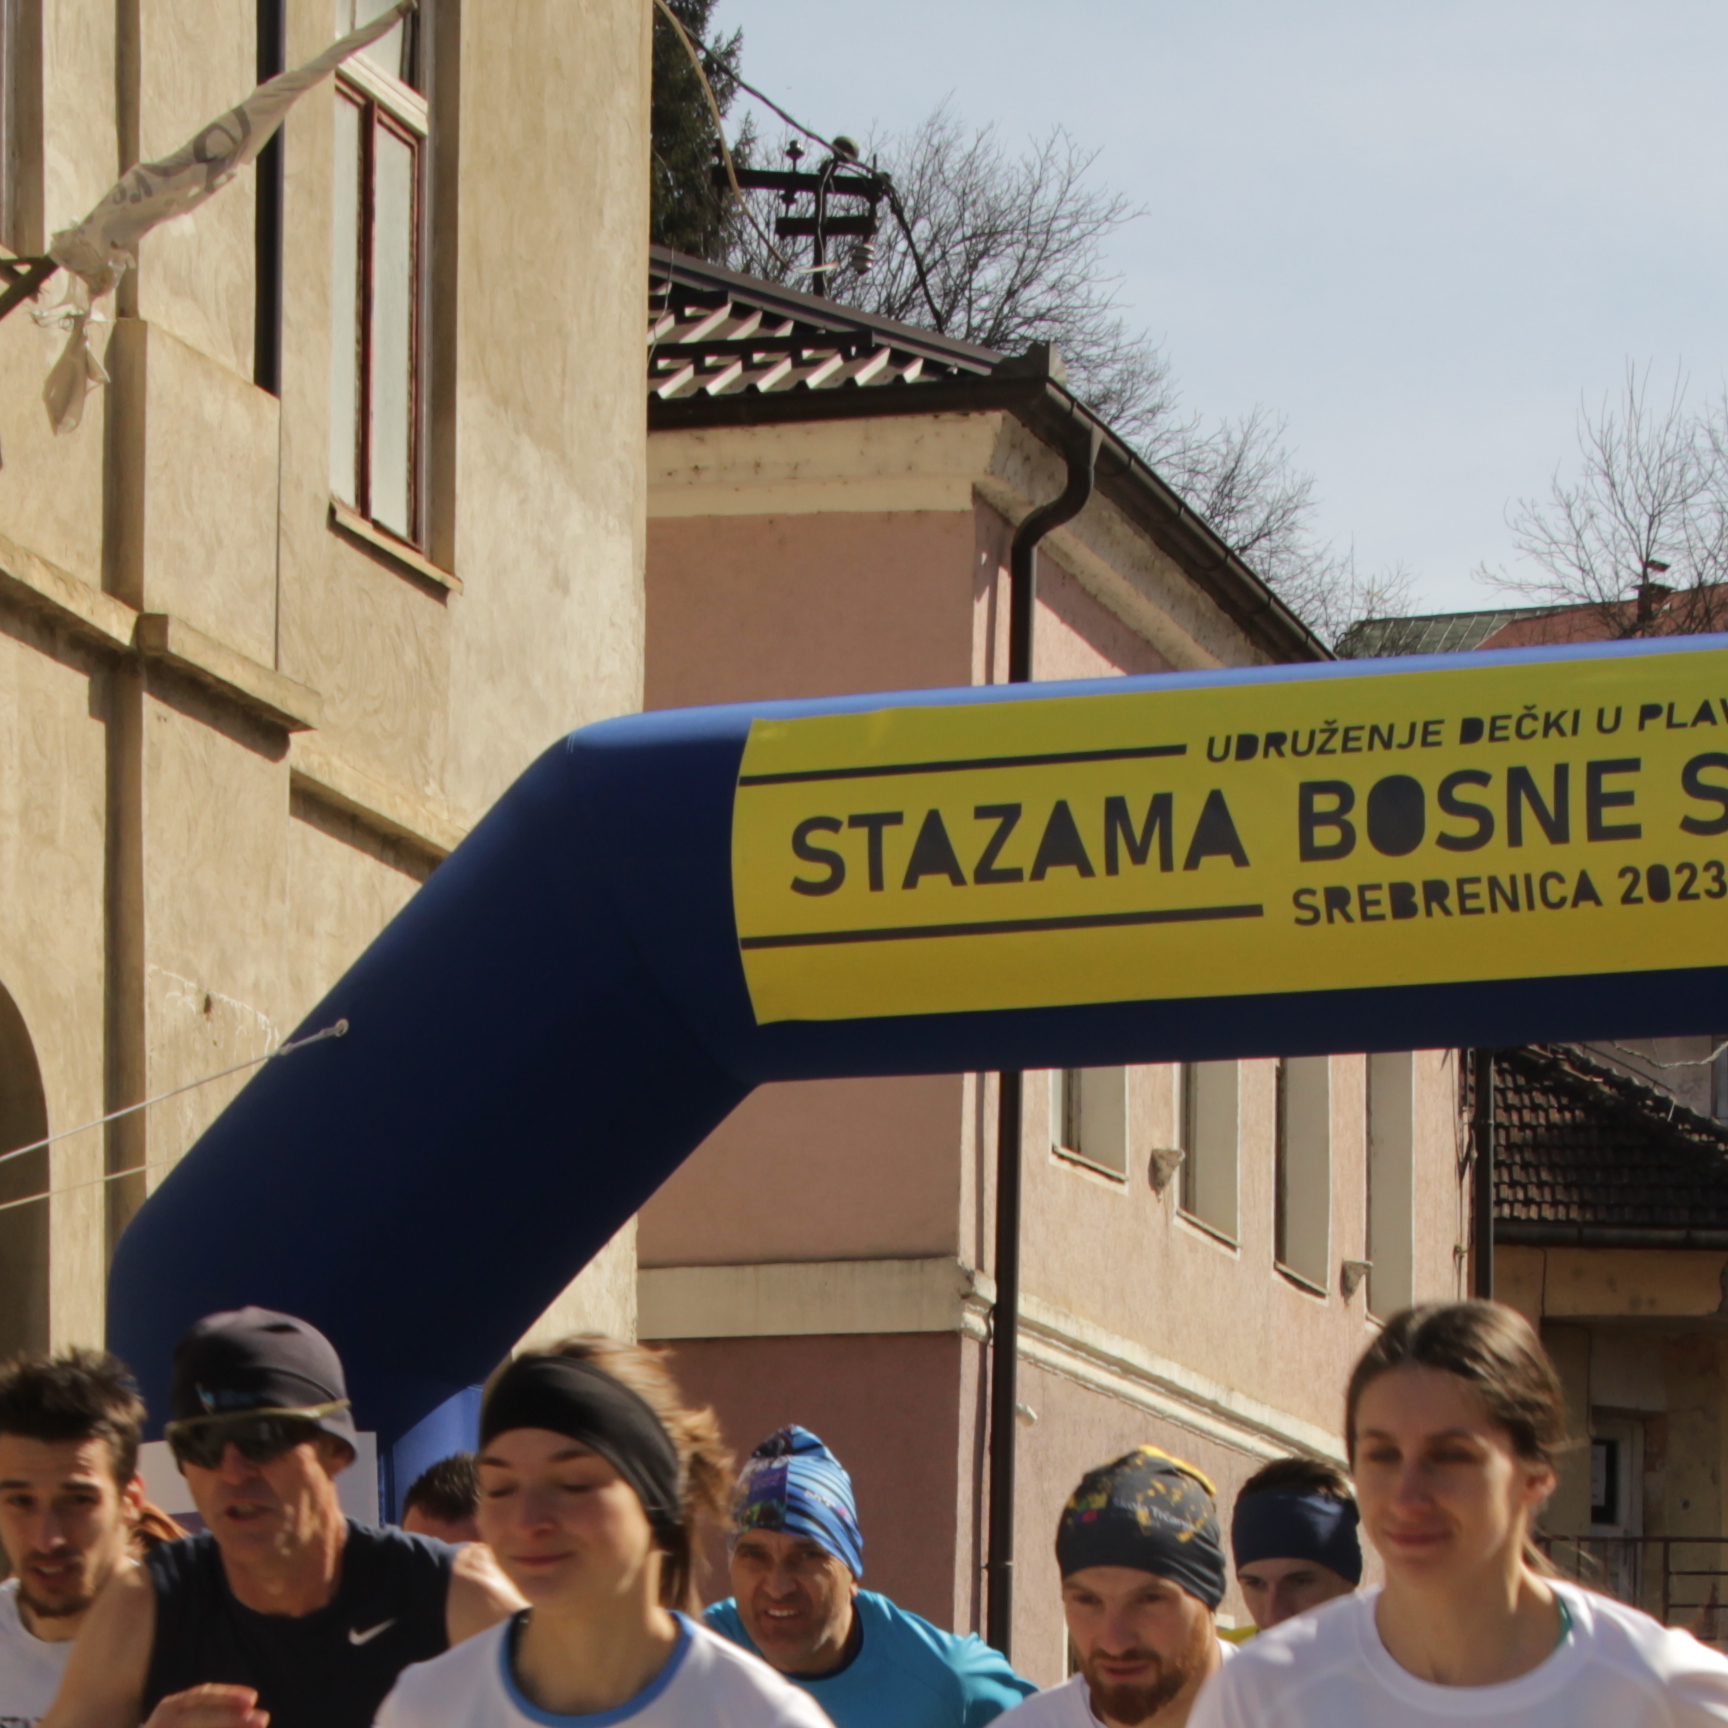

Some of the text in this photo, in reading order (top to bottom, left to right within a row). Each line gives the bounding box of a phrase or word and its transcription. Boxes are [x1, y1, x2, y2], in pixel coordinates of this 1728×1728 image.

[1206, 718, 1445, 764] UDRUŽENJE
[1459, 703, 1580, 746] DEČKI
[1596, 706, 1622, 735] U
[789, 788, 1250, 897] STAZAMA
[1298, 757, 1642, 862] BOSNE
[1292, 859, 1728, 927] SREBRENICA 2023
